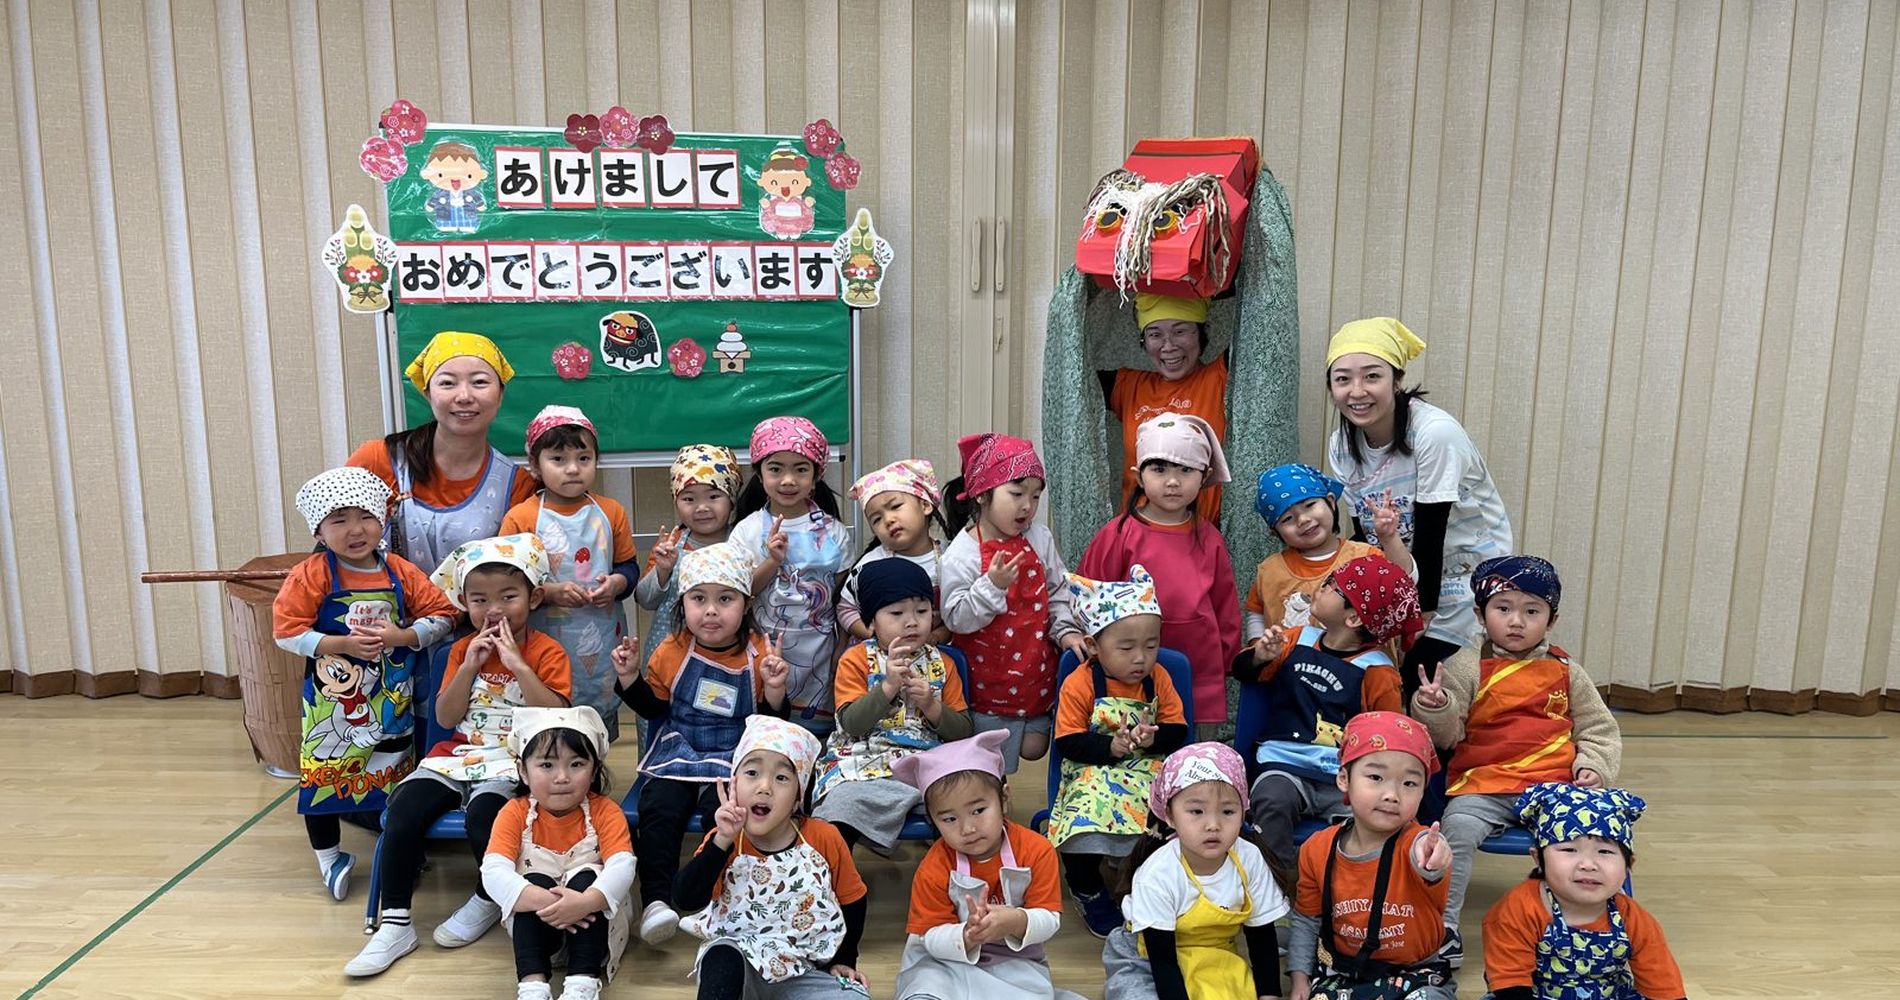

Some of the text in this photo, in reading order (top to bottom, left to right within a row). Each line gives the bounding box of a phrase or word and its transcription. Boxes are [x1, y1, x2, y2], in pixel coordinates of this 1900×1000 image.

[500, 157, 735, 198] あけまして
[402, 251, 834, 292] おめでとうございます
[1191, 760, 1212, 775] Your
